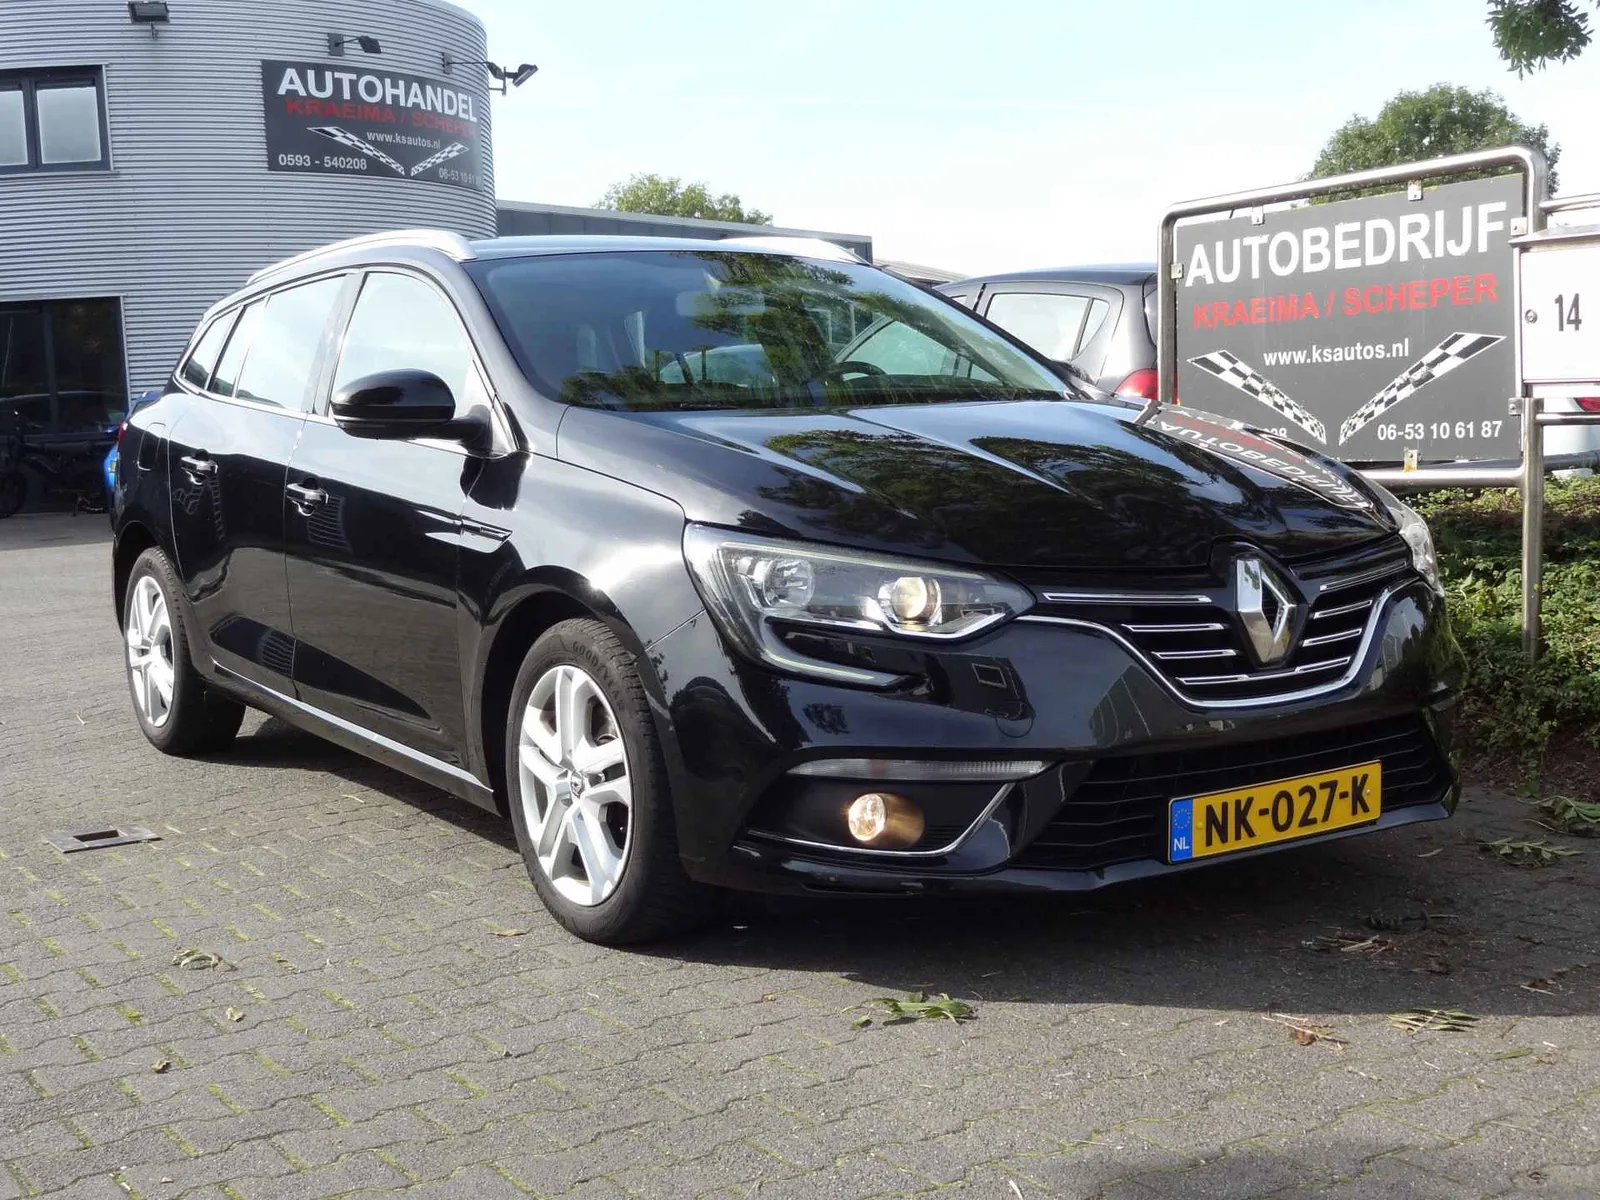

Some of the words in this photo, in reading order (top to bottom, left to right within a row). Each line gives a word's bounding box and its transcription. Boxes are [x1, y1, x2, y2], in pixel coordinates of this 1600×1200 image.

[277, 68, 478, 123] AUTOHANDEL
[285, 98, 397, 123] KRAEIMA
[366, 131, 441, 150] www.ksautos.nl
[278, 154, 312, 167] 0593
[323, 156, 368, 170] 540208
[1184, 201, 1508, 288] AUTOBEDRIJF
[1192, 291, 1320, 330] KRAEIMA
[1343, 273, 1499, 317] SCHEPER
[1554, 292, 1582, 332] 14
[1263, 338, 1410, 367] www.ksautos.nl
[1377, 423, 1425, 440] 06-53
[1430, 422, 1450, 439] 10
[1455, 421, 1474, 438] 61
[1481, 420, 1503, 438] 87
[1205, 773, 1370, 847] NK-027-K
[1173, 836, 1190, 851] NL
